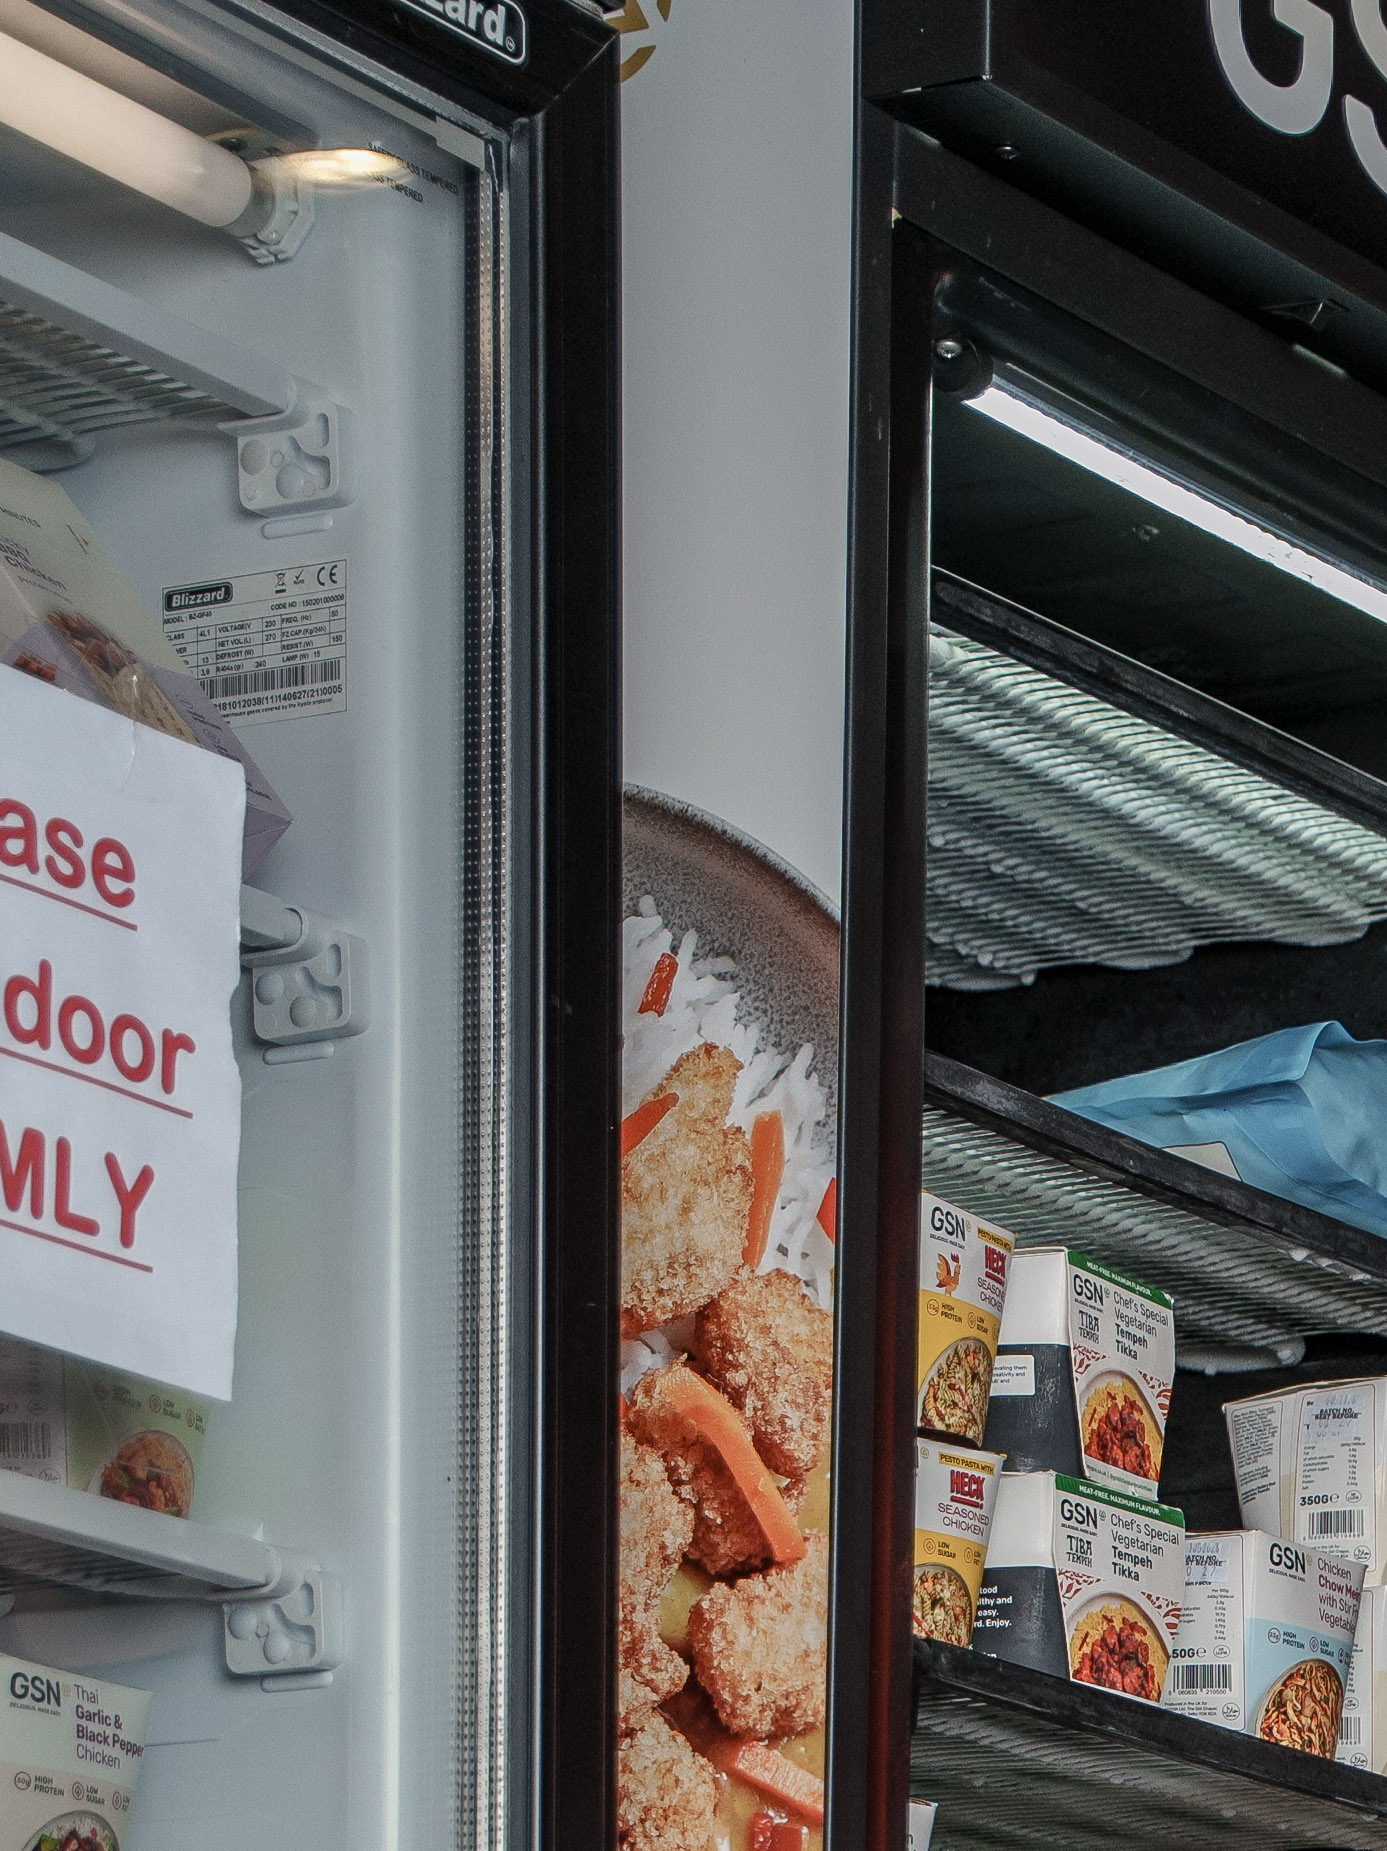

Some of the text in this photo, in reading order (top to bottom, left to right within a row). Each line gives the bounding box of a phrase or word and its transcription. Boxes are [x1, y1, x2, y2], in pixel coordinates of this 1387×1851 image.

[172, 589, 225, 607] Blizzard
[265, 633, 276, 641] 270
[3, 958, 196, 1095] door
[951, 1470, 986, 1501] HECK
[1300, 1494, 1329, 1507] 350G
[937, 1502, 990, 1526] SEASONED
[1060, 1498, 1098, 1530] GSN
[942, 1516, 985, 1538] CHICKEN
[1110, 1514, 1179, 1546] Chef's Special
[1066, 1534, 1092, 1556] TIBA
[1112, 1530, 1164, 1557] Vegetarian
[1066, 1551, 1092, 1568] TEMPEH
[1112, 1546, 1153, 1570] Tempeh
[1112, 1562, 1140, 1581] Tikka
[978, 1608, 999, 1617] easy.
[986, 1618, 1012, 1628] Enjoy.
[10, 1672, 61, 1708] GSN
[74, 1684, 99, 1705] Thai
[76, 1705, 111, 1727] Garlic
[114, 1715, 123, 1730] &
[77, 1724, 110, 1747] Black
[77, 1744, 121, 1770] Chicken
